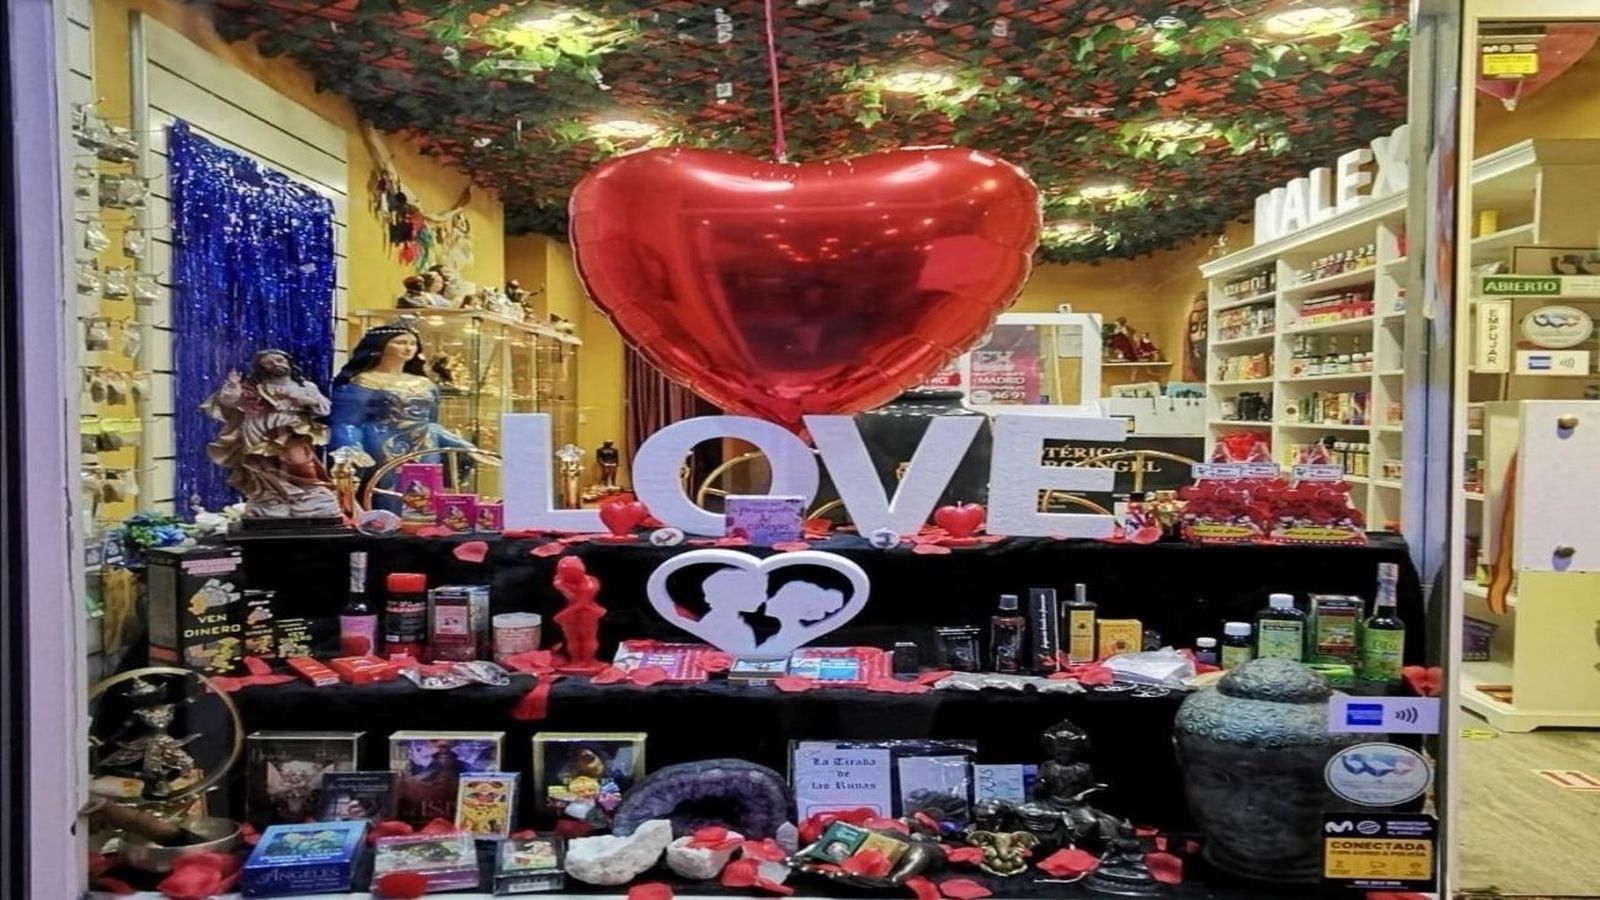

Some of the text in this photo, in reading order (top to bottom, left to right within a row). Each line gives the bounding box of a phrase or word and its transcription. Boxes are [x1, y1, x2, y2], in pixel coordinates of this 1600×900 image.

[1484, 281, 1557, 292] ABIERTO
[1487, 309, 1499, 364] EMPUJAR
[978, 376, 1025, 385] MADRID
[502, 413, 1128, 538] LOVE
[198, 614, 227, 623] VEN
[184, 624, 241, 638] DINERO
[813, 758, 876, 766] La Tirada
[1330, 841, 1426, 851] CONECTADA
